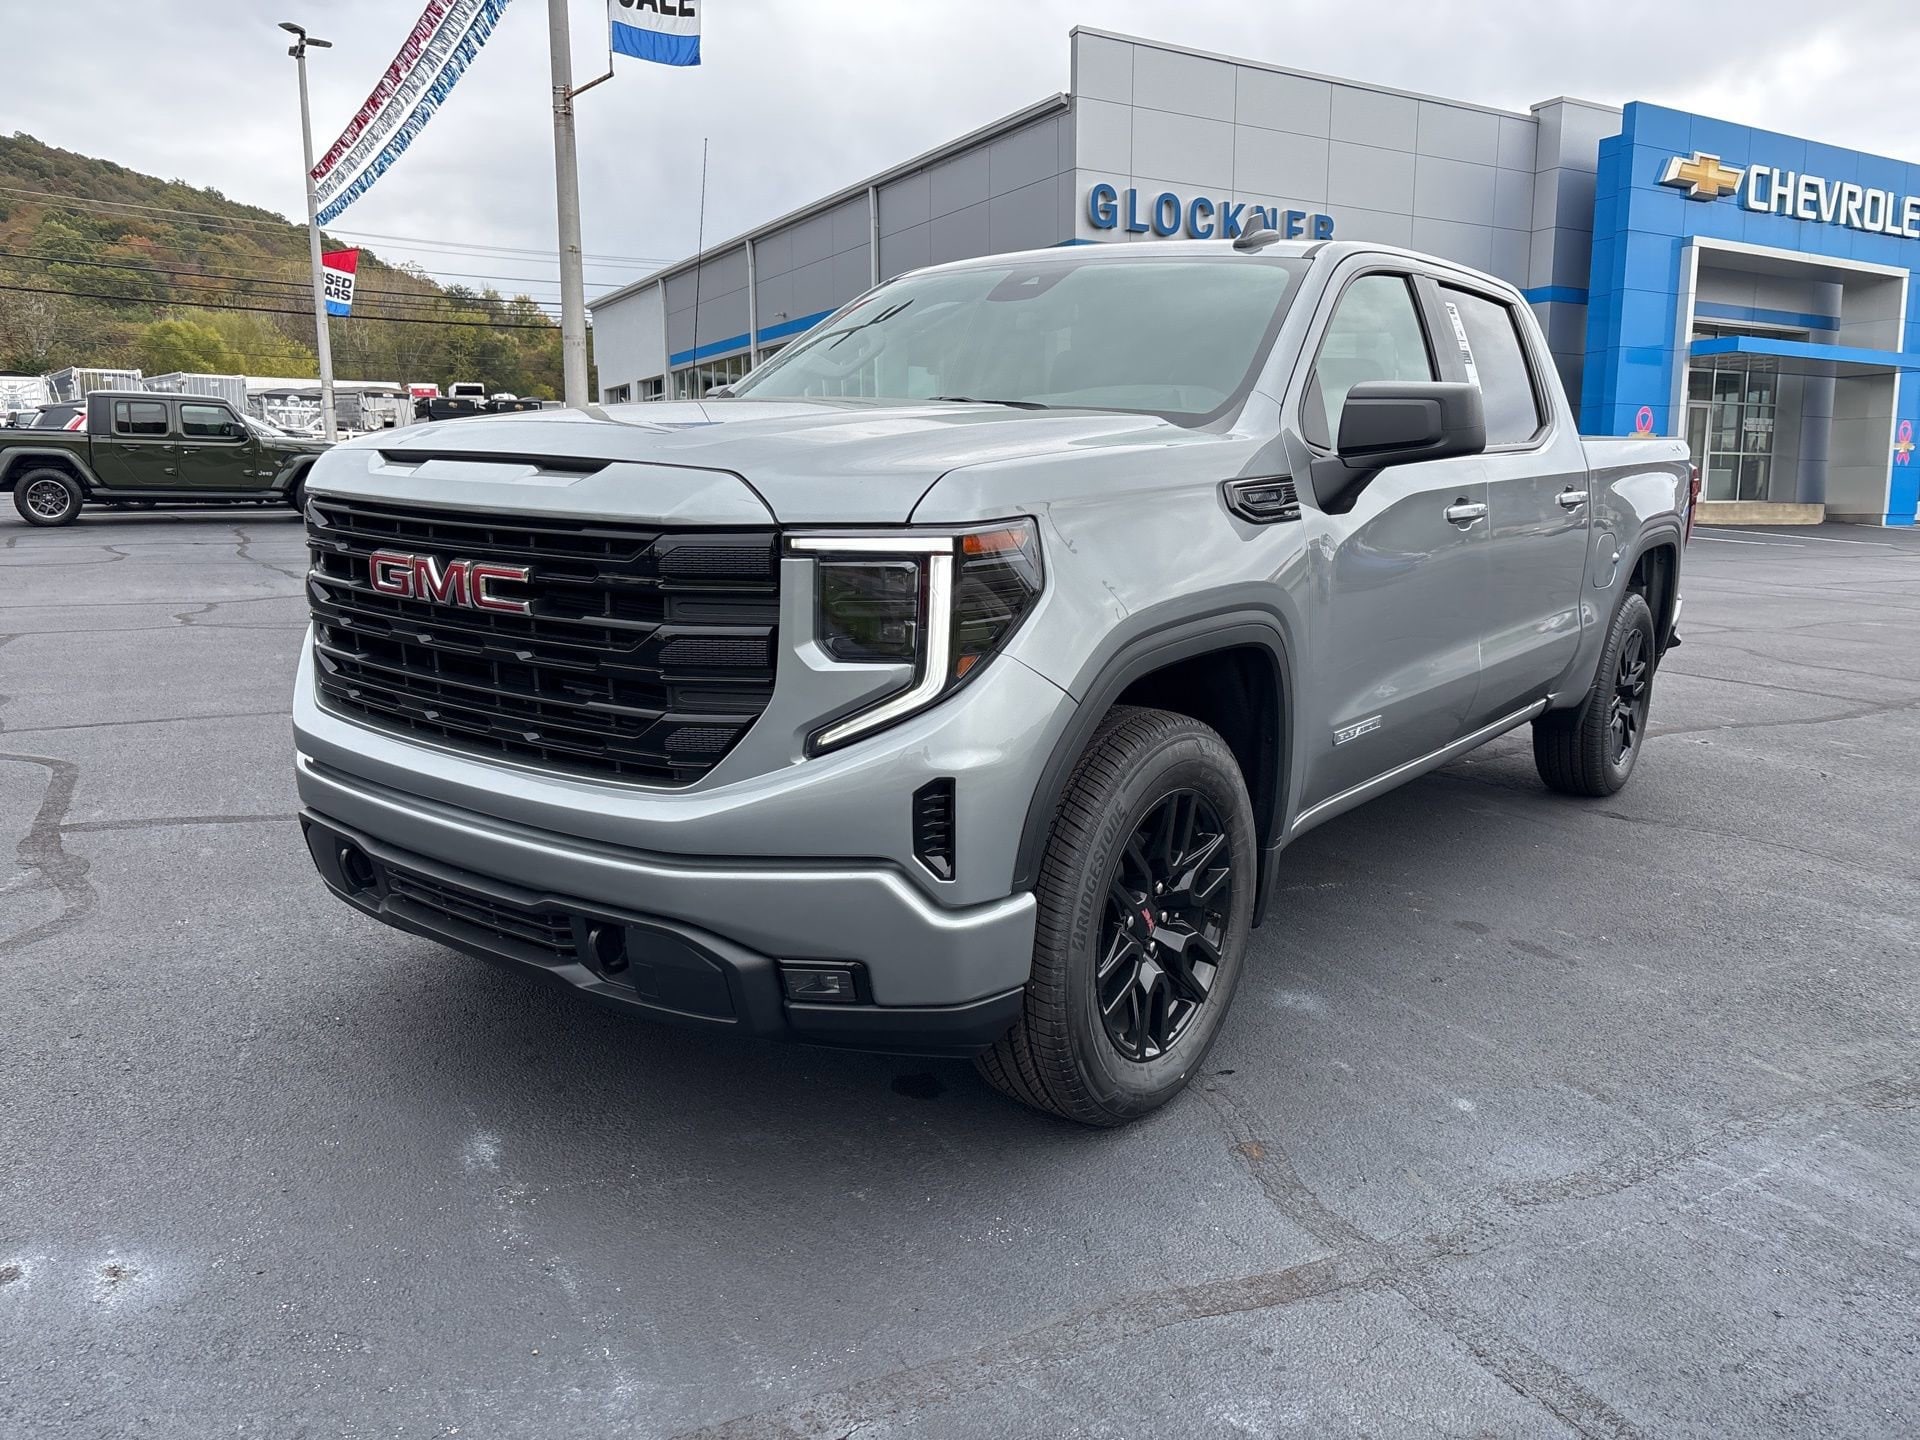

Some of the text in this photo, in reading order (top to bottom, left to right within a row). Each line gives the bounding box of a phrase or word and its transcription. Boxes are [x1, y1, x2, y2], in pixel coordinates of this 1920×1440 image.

[322, 272, 352, 289] SED
[324, 286, 351, 301] ARS
[370, 548, 534, 616] GMC
[1071, 801, 1128, 954] BRIDGESTONE
